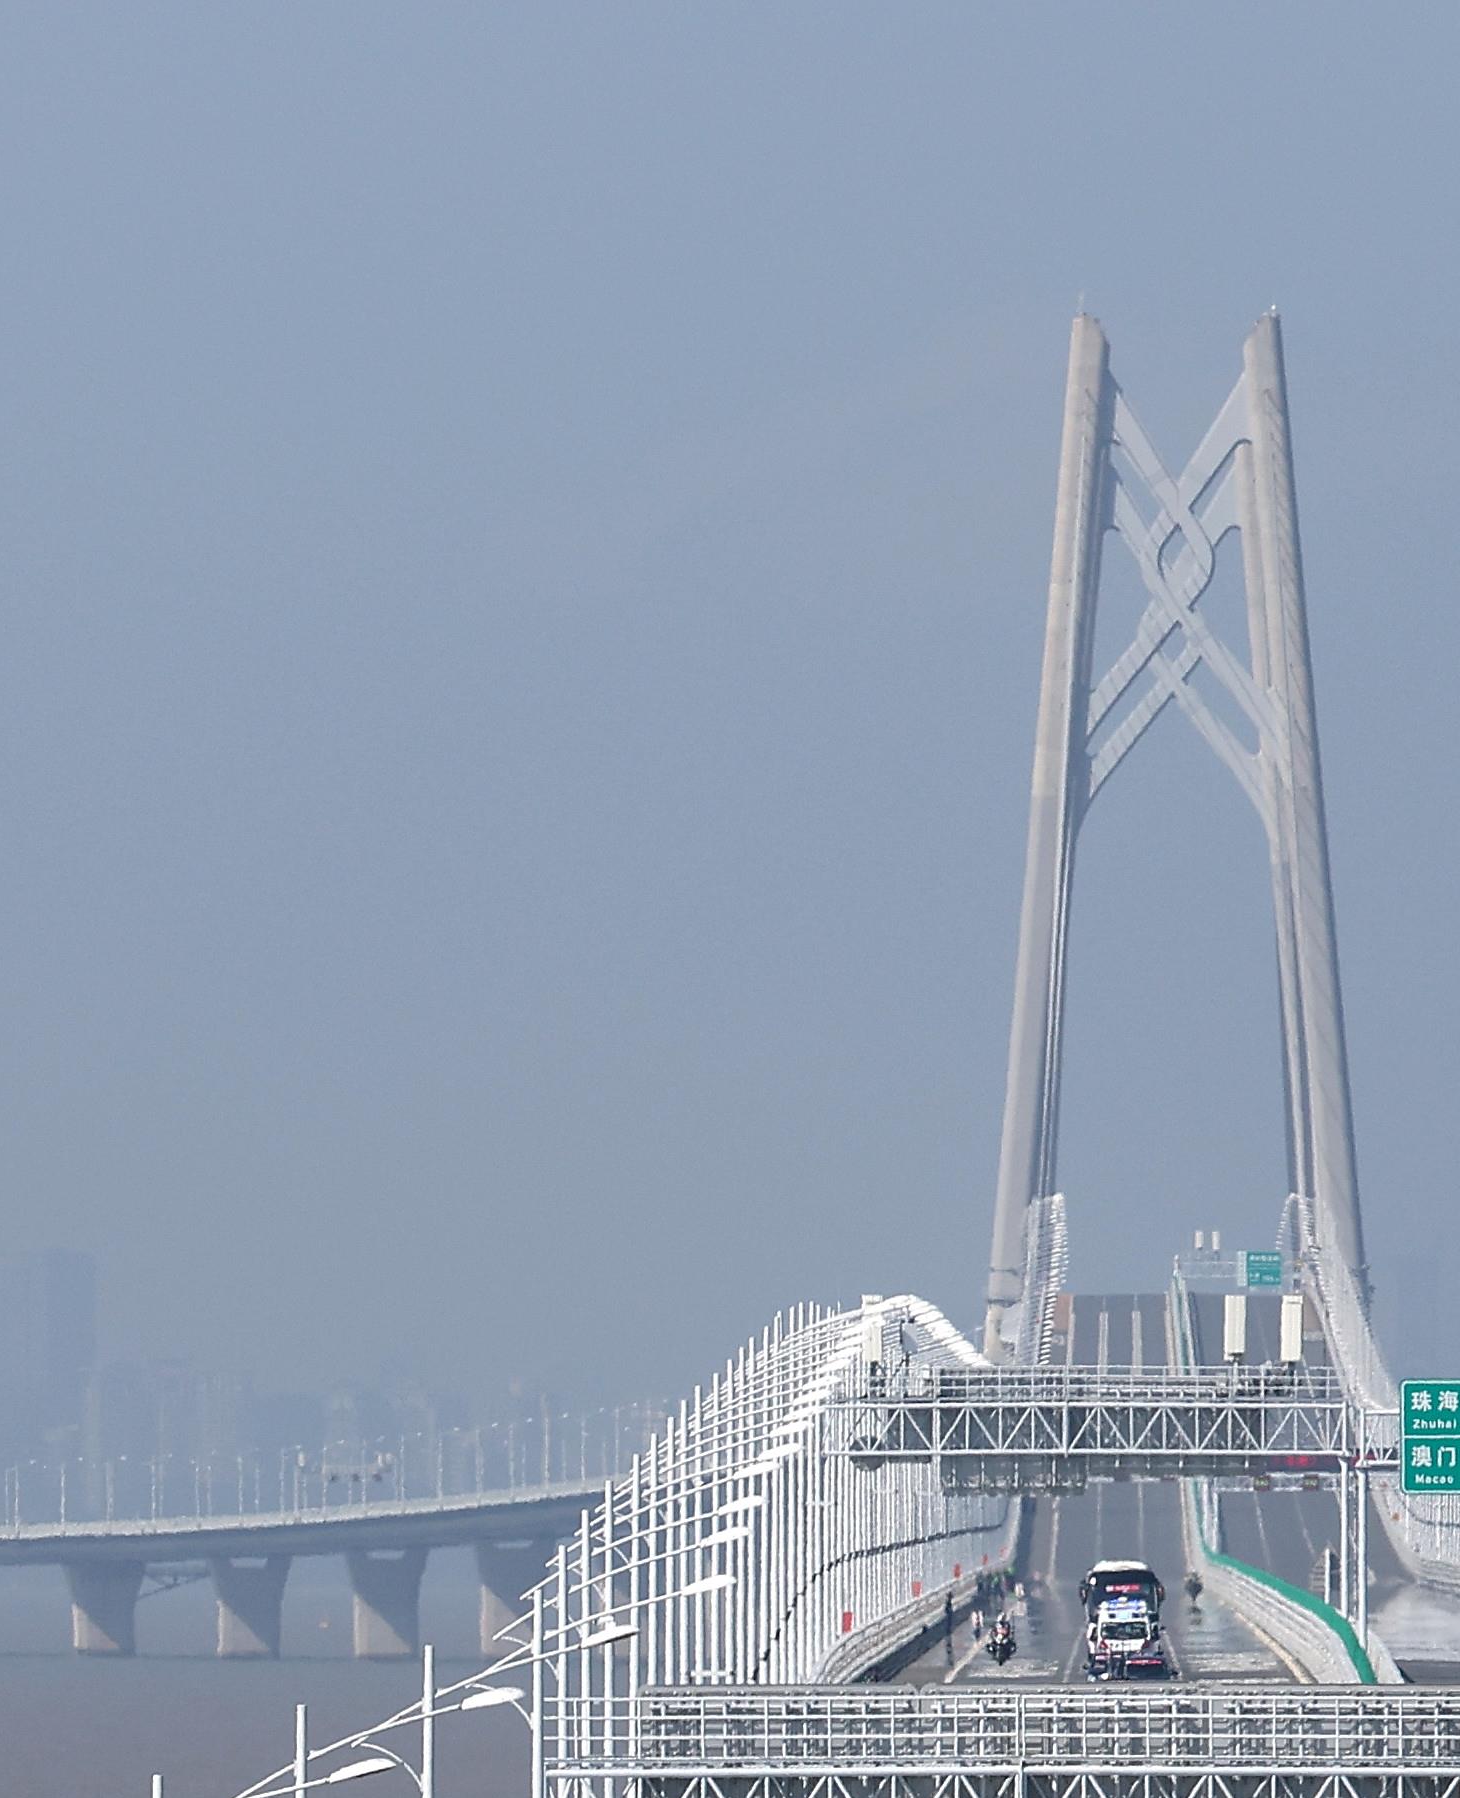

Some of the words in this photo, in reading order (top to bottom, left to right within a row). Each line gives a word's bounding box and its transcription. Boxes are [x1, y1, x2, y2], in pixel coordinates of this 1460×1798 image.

[1411, 1390, 1459, 1412] 珠海
[1412, 1418, 1457, 1430] Zhuhai
[1411, 1444, 1456, 1467] 澳门
[1415, 1474, 1454, 1484] Macao
